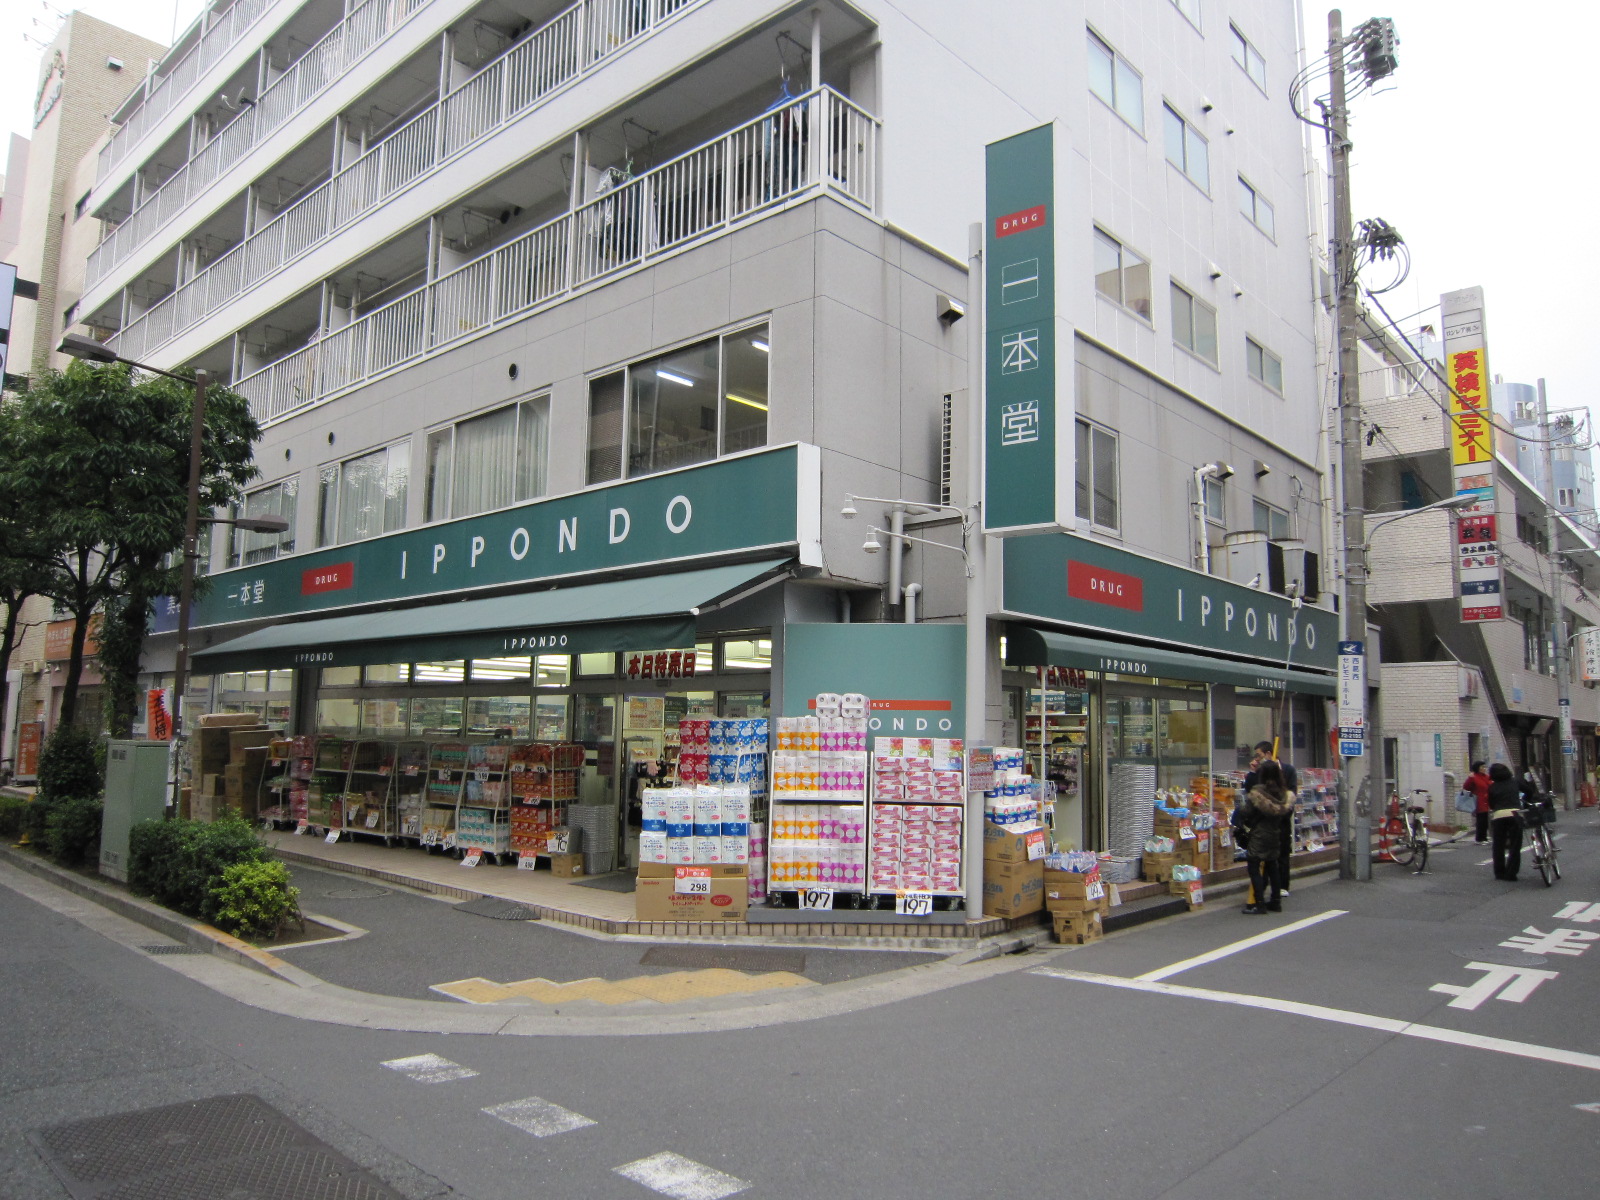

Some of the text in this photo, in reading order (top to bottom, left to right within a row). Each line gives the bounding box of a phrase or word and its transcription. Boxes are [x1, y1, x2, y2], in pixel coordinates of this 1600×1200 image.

[1002, 213, 1038, 230] DRUG
[1001, 270, 1039, 447] 一本堂
[1452, 350, 1484, 462] 英検セミナー
[400, 495, 693, 580] IPPONDO
[315, 573, 338, 585] DRUG
[1090, 577, 1123, 597] DRUG
[227, 579, 265, 605] 一本堂
[1177, 588, 1316, 650] IPPONDO
[503, 634, 569, 650] IPPONDO
[295, 652, 334, 664] IPPONDO
[627, 650, 696, 680] 本日特売日
[1100, 658, 1147, 674] IPPONDO
[1257, 678, 1287, 690] IPPONDO
[153, 694, 168, 741] 本日特
[868, 717, 952, 731] ONDO
[690, 883, 707, 892] 298
[803, 890, 831, 908] 197
[903, 898, 928, 914] 197
